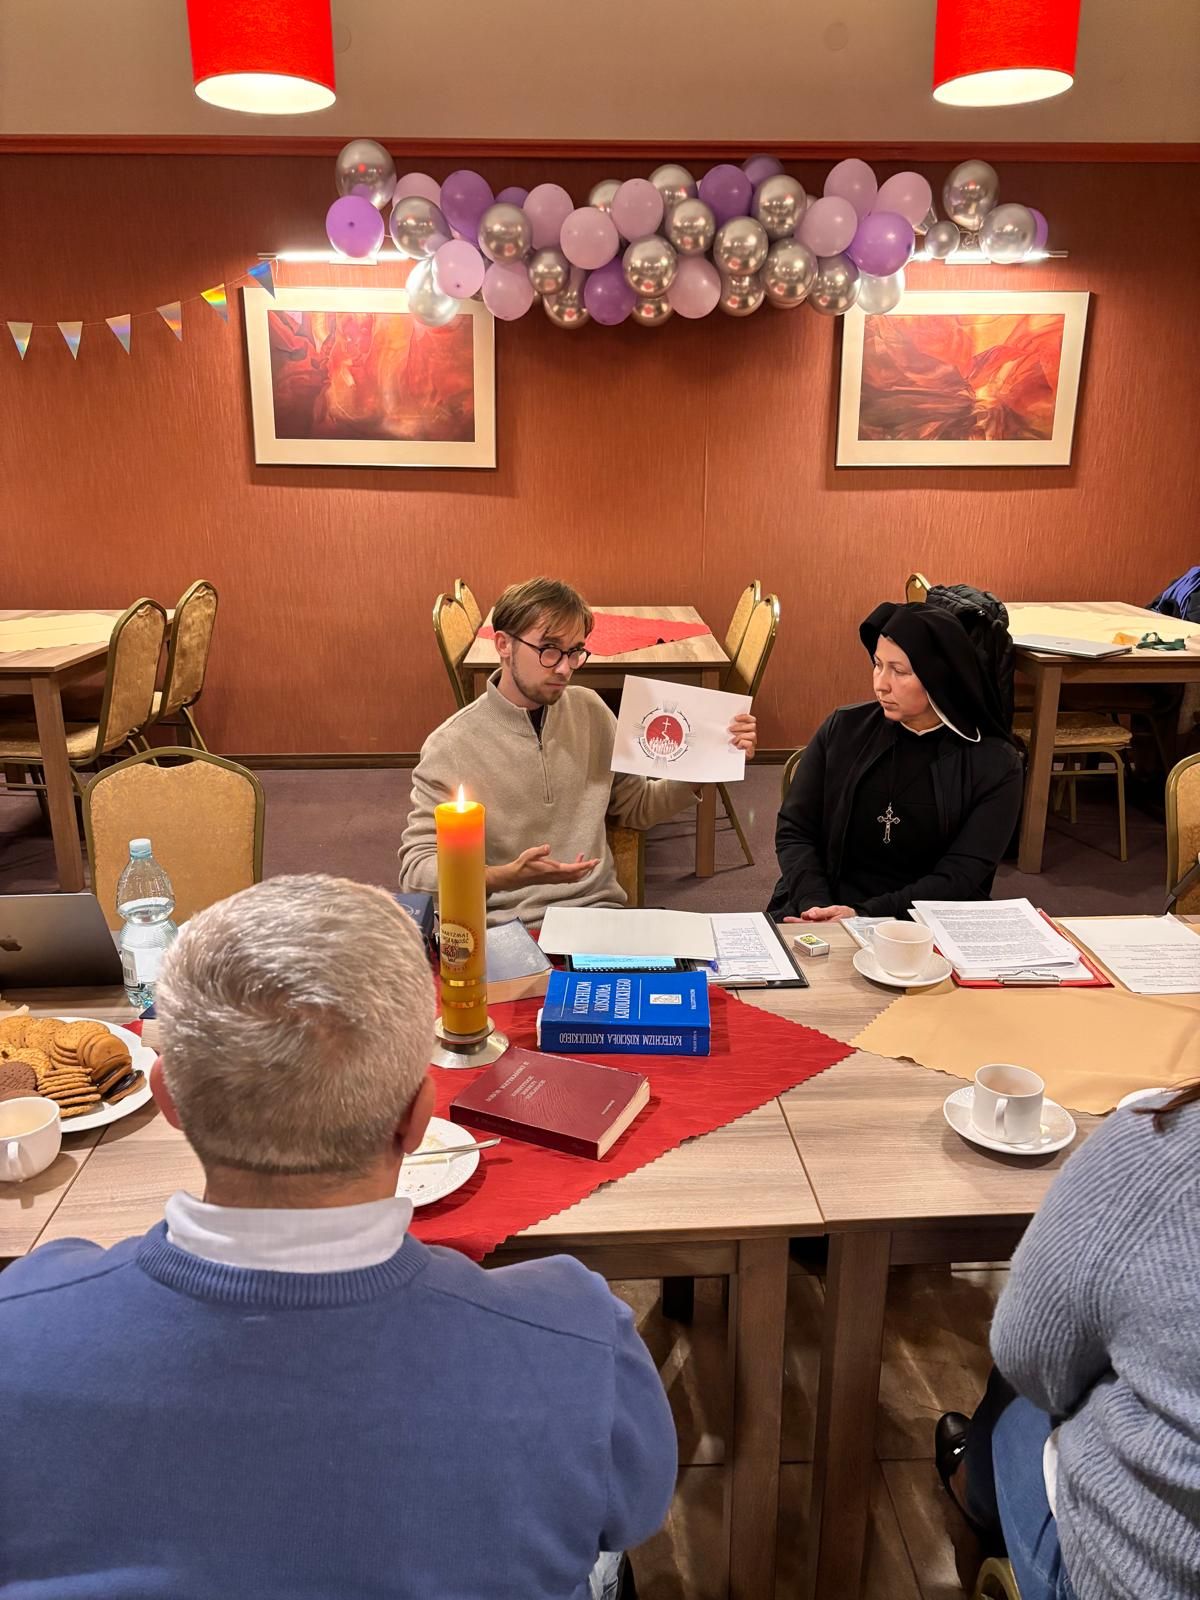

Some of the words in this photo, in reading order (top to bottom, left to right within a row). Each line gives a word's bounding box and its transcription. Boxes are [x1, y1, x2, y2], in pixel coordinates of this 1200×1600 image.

[572, 981, 592, 1014] KATECHIZM
[593, 983, 611, 1012] KOŚCIOŁA
[614, 978, 631, 1018] KATOLICKIEGO
[559, 1032, 604, 1044] KATOLICKIEGO
[607, 1033, 640, 1046] KOŚCIOŁA
[642, 1034, 682, 1046] KATECHIZM
